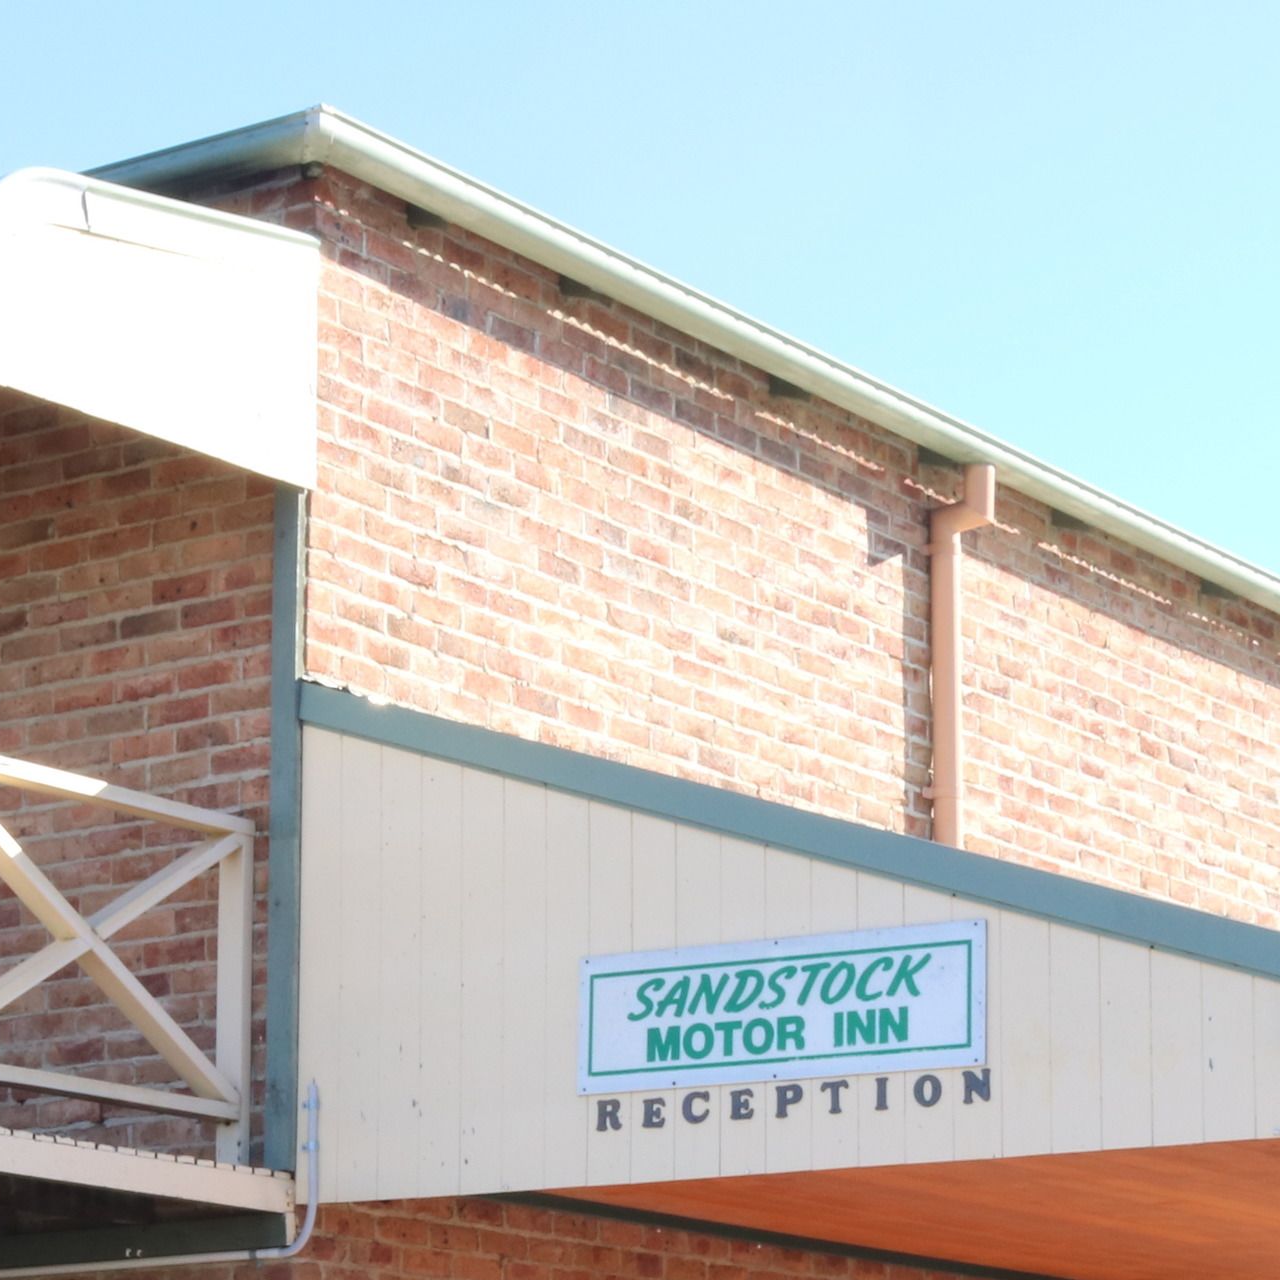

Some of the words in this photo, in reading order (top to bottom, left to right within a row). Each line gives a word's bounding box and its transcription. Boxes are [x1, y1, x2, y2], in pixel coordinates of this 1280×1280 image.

[627, 953, 932, 1022] SANDSTOCK
[646, 1015, 806, 1063] MOTOR
[833, 1006, 909, 1049] INN
[595, 1068, 992, 1132] RECEPTION
